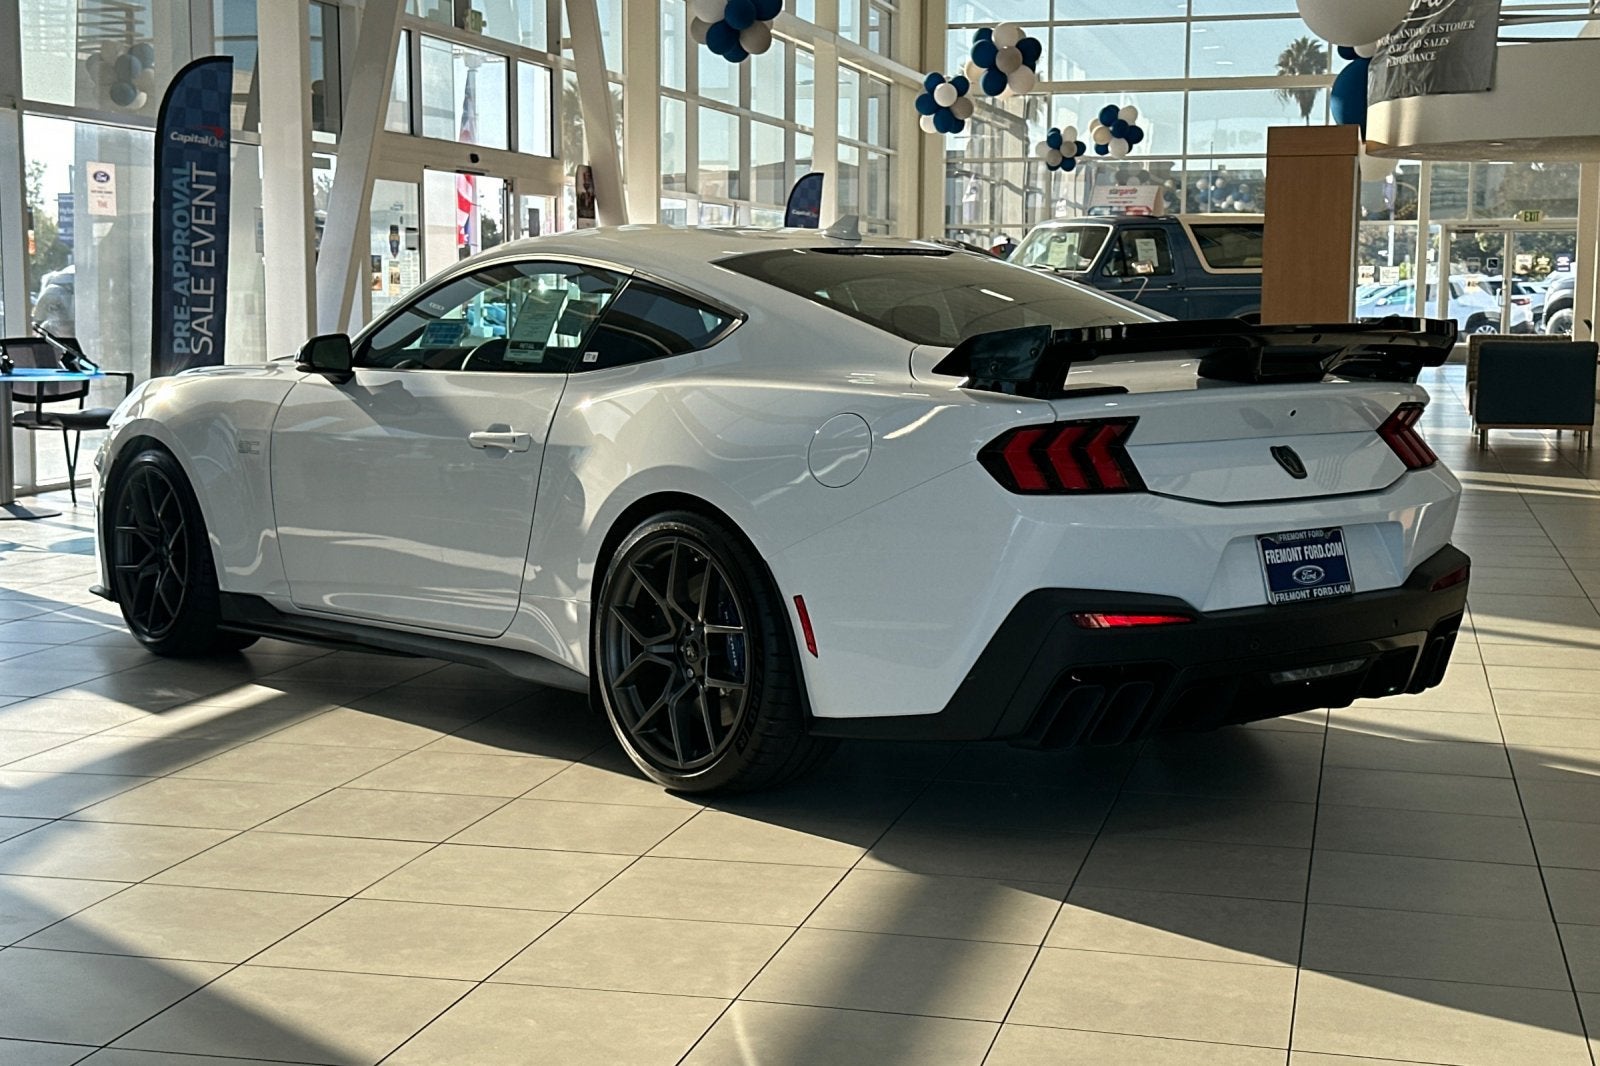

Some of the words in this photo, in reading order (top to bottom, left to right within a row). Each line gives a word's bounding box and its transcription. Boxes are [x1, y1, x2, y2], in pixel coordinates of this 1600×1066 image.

[1427, 20, 1475, 32] CUSTOMER
[1424, 37, 1450, 49] SALES
[191, 161, 217, 268] EVENT
[1524, 210, 1540, 222] EXIT
[172, 161, 191, 355] PRE-APPROVAL
[191, 277, 215, 356] SALE
[1279, 532, 1306, 541] FREMONT
[1308, 529, 1324, 538] FORD
[1265, 547, 1302, 564] FREMONT
[1304, 542, 1343, 559] FORD.COM
[1301, 570, 1317, 580] Ford
[1275, 589, 1310, 602] FREMONT
[1313, 584, 1351, 598] FORD.COM
